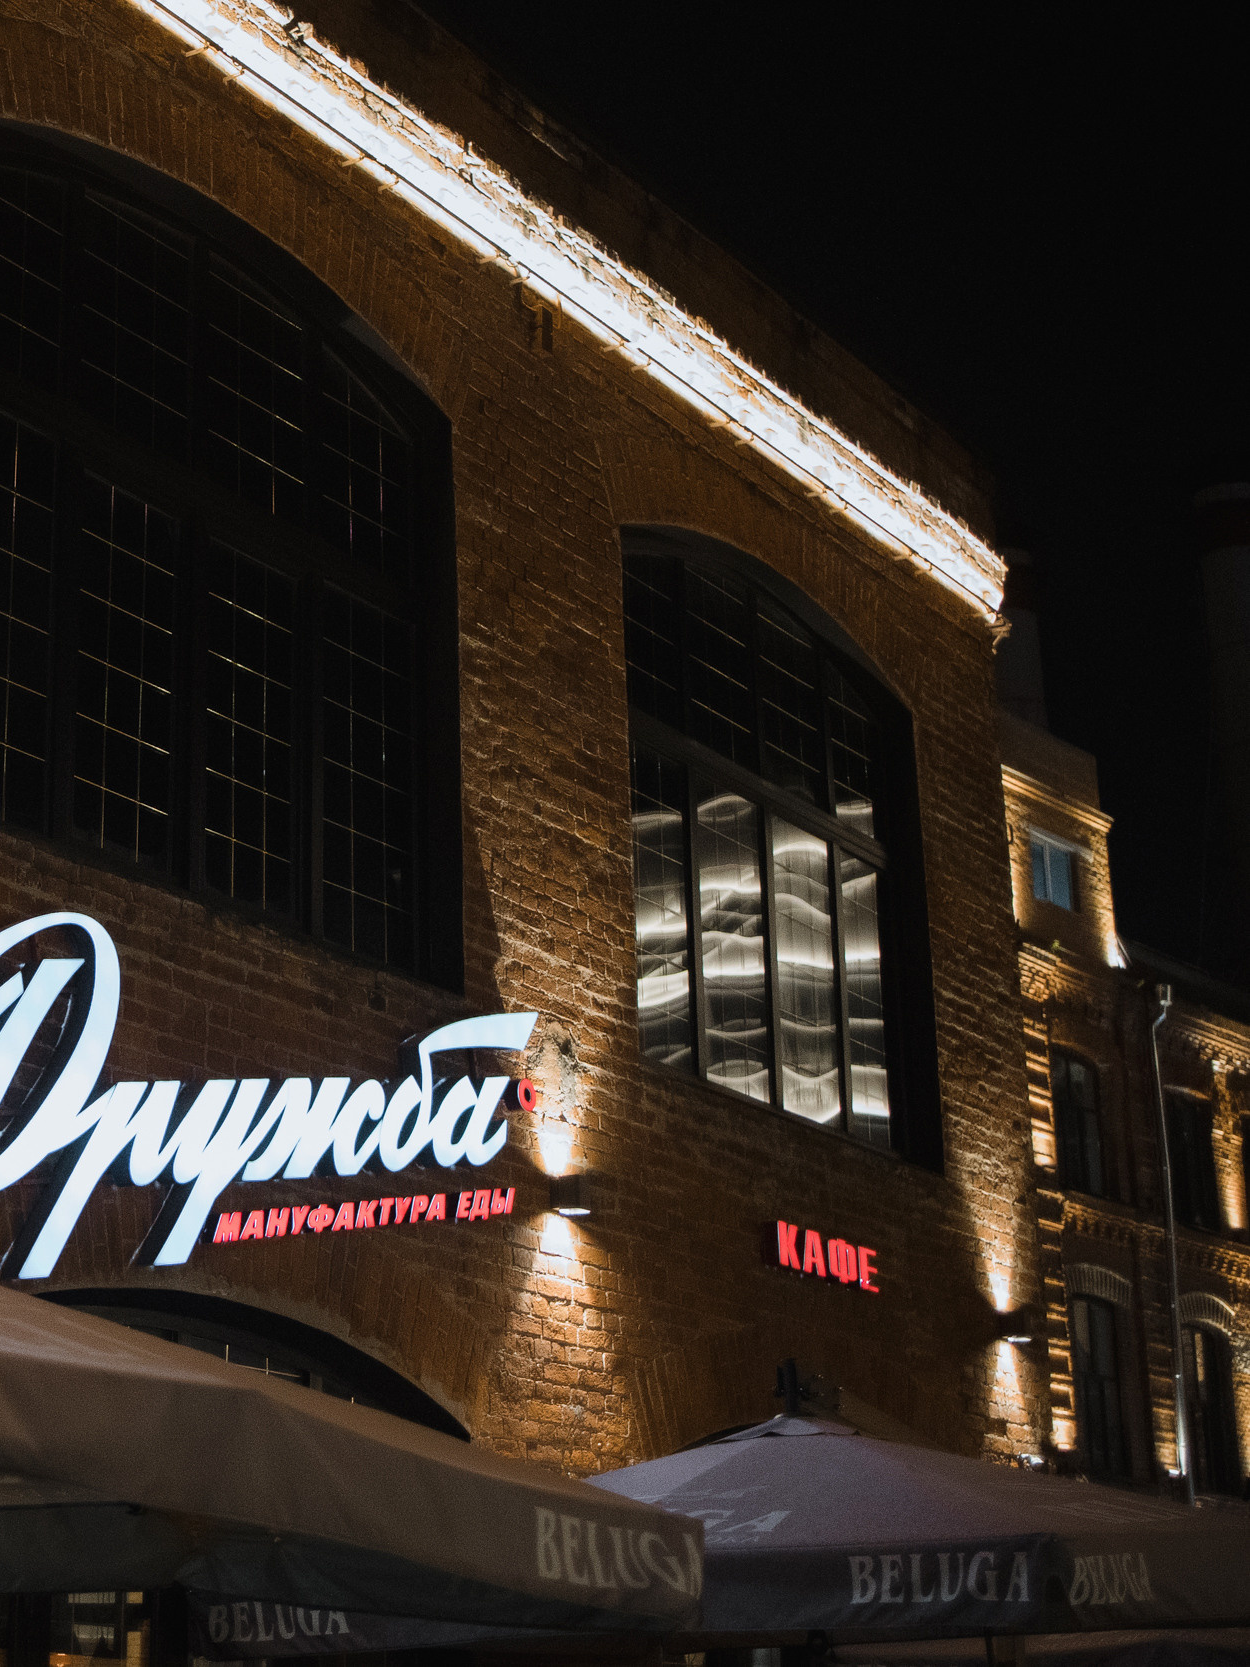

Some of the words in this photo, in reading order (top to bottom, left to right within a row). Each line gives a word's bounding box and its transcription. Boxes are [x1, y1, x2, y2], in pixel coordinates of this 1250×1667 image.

[213, 1193, 447, 1243] МАНУФАКТУРА
[456, 1187, 516, 1222] ЕДЫ
[776, 1219, 880, 1294] КАФЕ
[848, 1550, 1031, 1604] BELUGA
[1068, 1552, 1157, 1607] BELUGA
